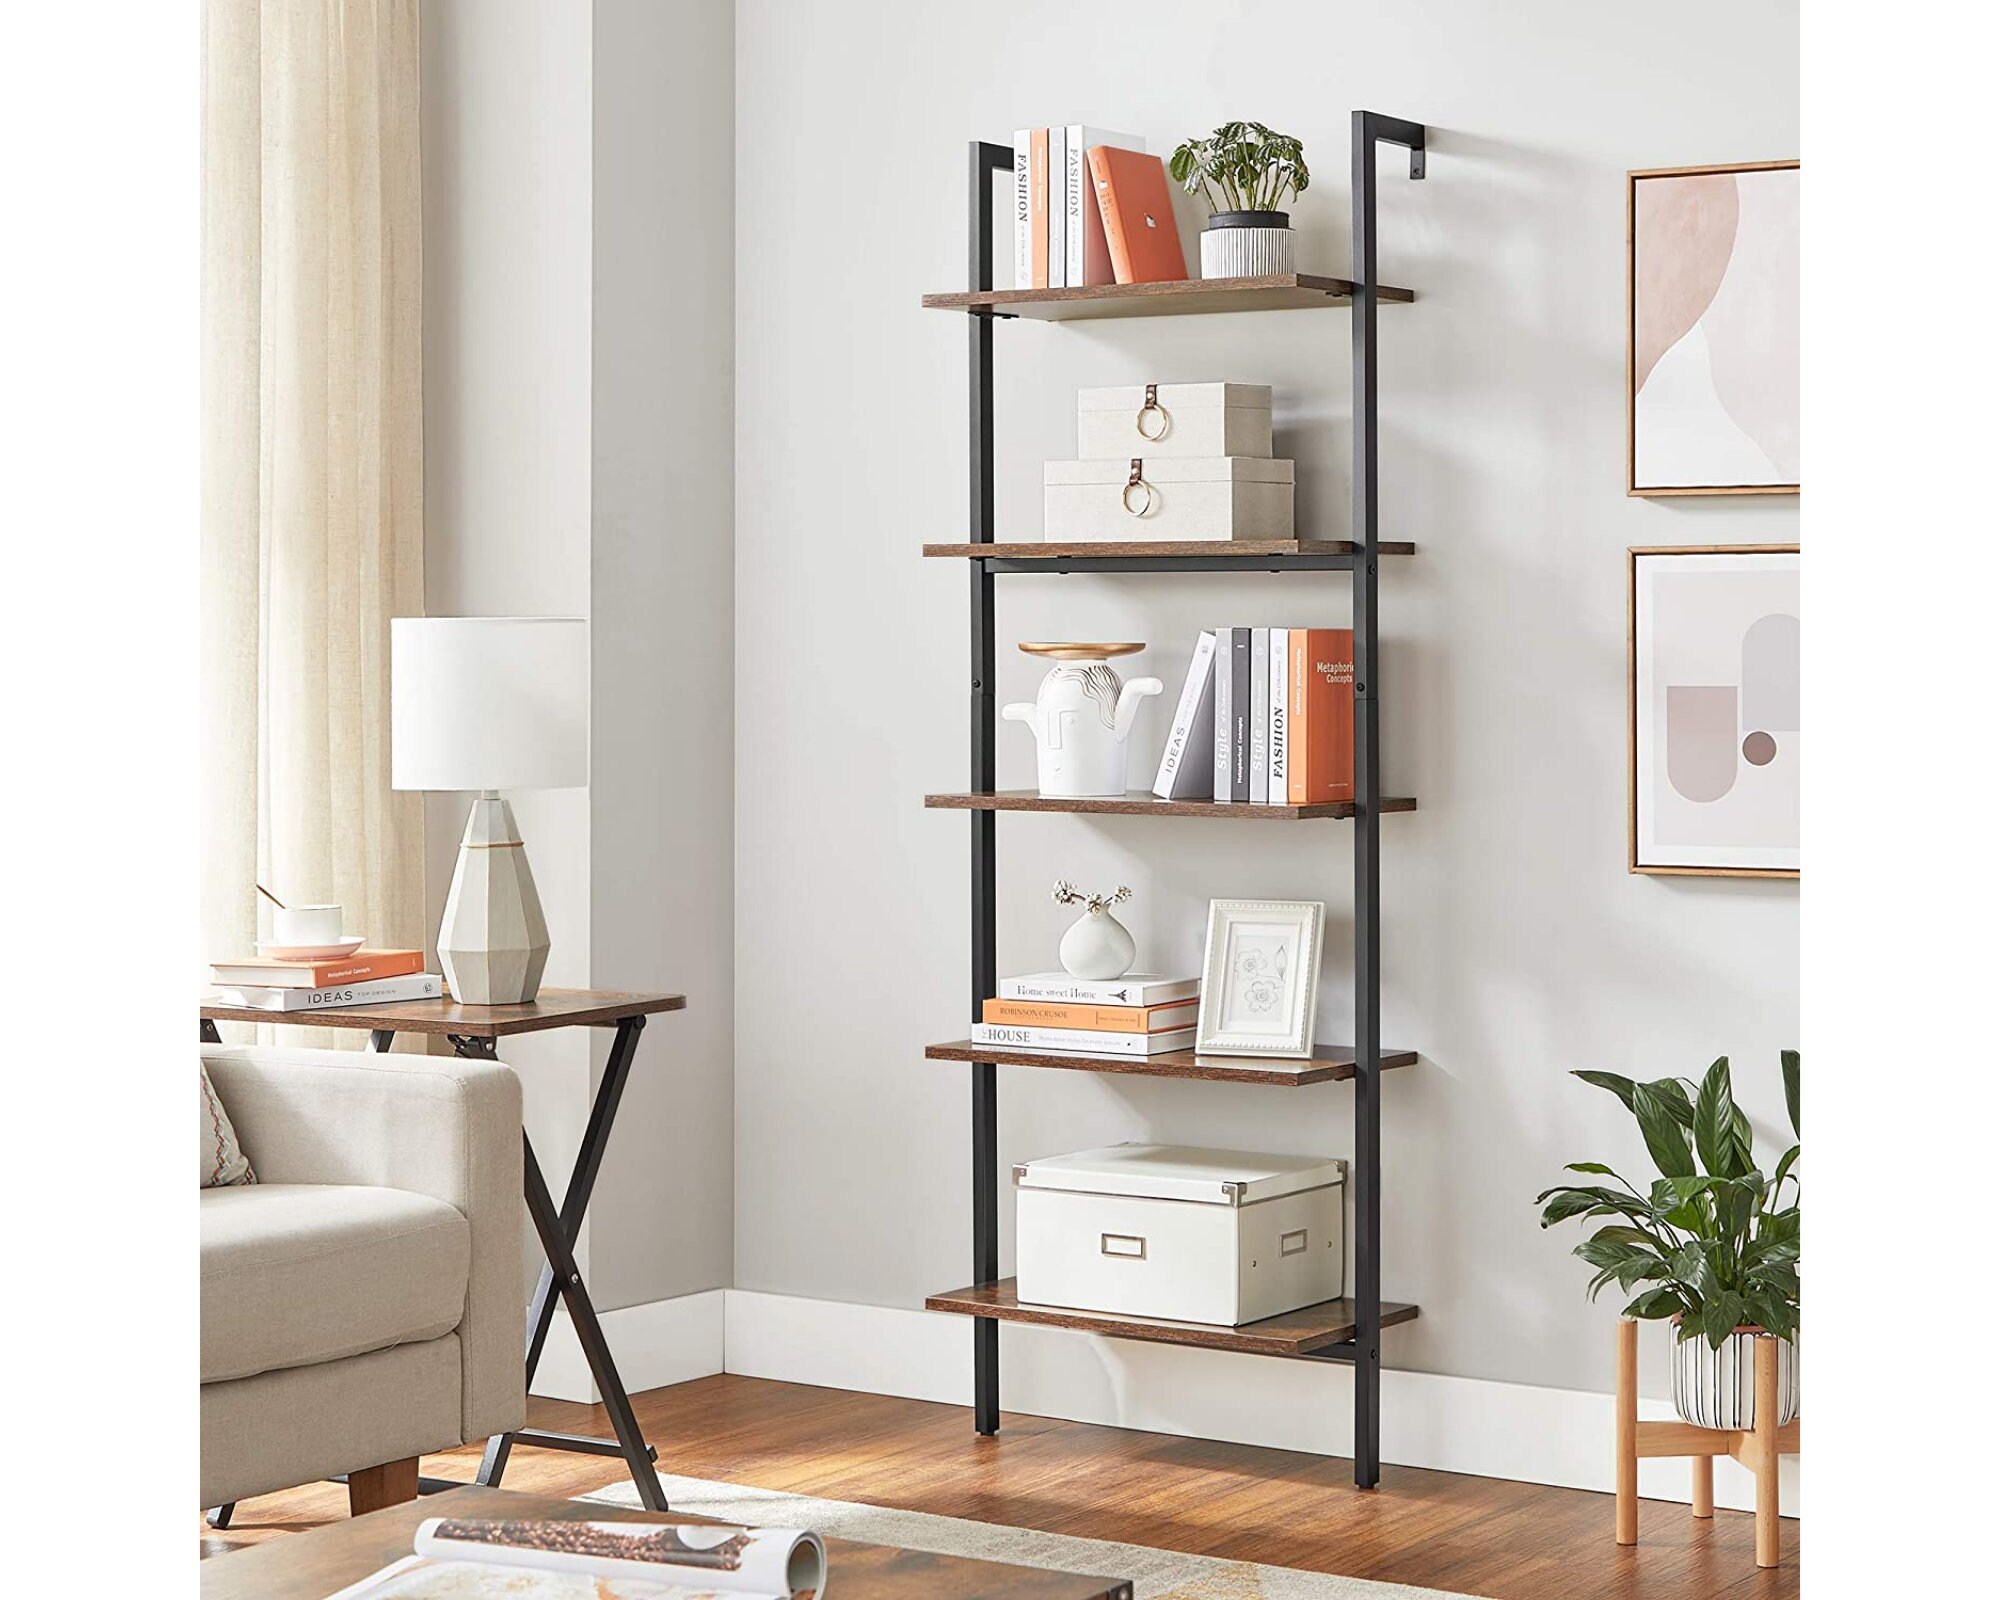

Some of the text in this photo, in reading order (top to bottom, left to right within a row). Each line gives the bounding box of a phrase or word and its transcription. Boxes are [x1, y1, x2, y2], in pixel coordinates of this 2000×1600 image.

[1018, 154, 1028, 222] FASHION
[1070, 148, 1078, 217] FASHION
[1326, 674, 1353, 685] Concepts
[1164, 726, 1185, 773] IDEAS
[1217, 728, 1229, 770] Style
[1252, 729, 1265, 772] Style
[1273, 706, 1283, 778] FASHION
[308, 990, 353, 1004] IDEAS
[1000, 1007, 1038, 1016] ROBINSON
[1038, 1010, 1068, 1019] CRUSOE
[1017, 985, 1097, 999] Home sweet Home
[988, 1028, 1031, 1042] HOUSE
